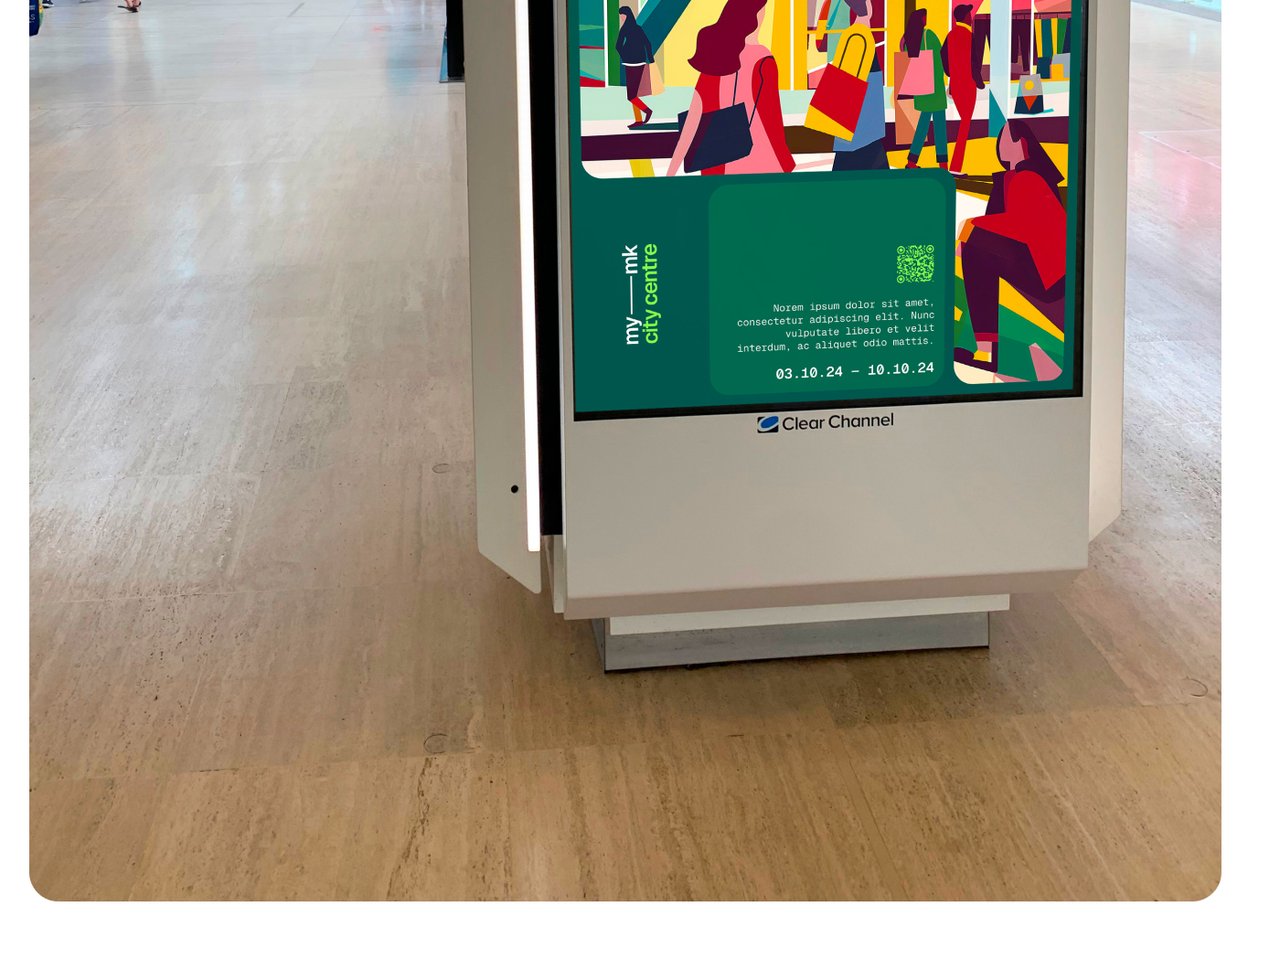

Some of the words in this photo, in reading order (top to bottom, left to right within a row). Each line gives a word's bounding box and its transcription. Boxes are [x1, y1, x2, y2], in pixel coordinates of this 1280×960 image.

[642, 244, 658, 305] centre
[773, 304, 804, 312] Norem
[810, 302, 840, 312] ipsum
[845, 301, 875, 309] dolor
[882, 300, 899, 308] sit
[905, 299, 934, 307] amet,
[642, 309, 661, 344] city
[737, 317, 803, 327] consectetur
[810, 313, 869, 324] adipiscing
[875, 312, 904, 321] elit.
[911, 311, 935, 320] Nunc
[786, 328, 839, 338] vulputate
[846, 327, 881, 335] libero
[887, 325, 899, 334] et
[905, 324, 934, 332] velit
[737, 343, 790, 352] interdum,
[815, 340, 857, 350] aliquet
[863, 339, 887, 347] odio
[892, 337, 933, 346] mattis.
[776, 366, 842, 380] 03.10.24
[868, 362, 934, 375] 10.10.24
[782, 417, 825, 430] Clear
[828, 412, 894, 428] Channel
